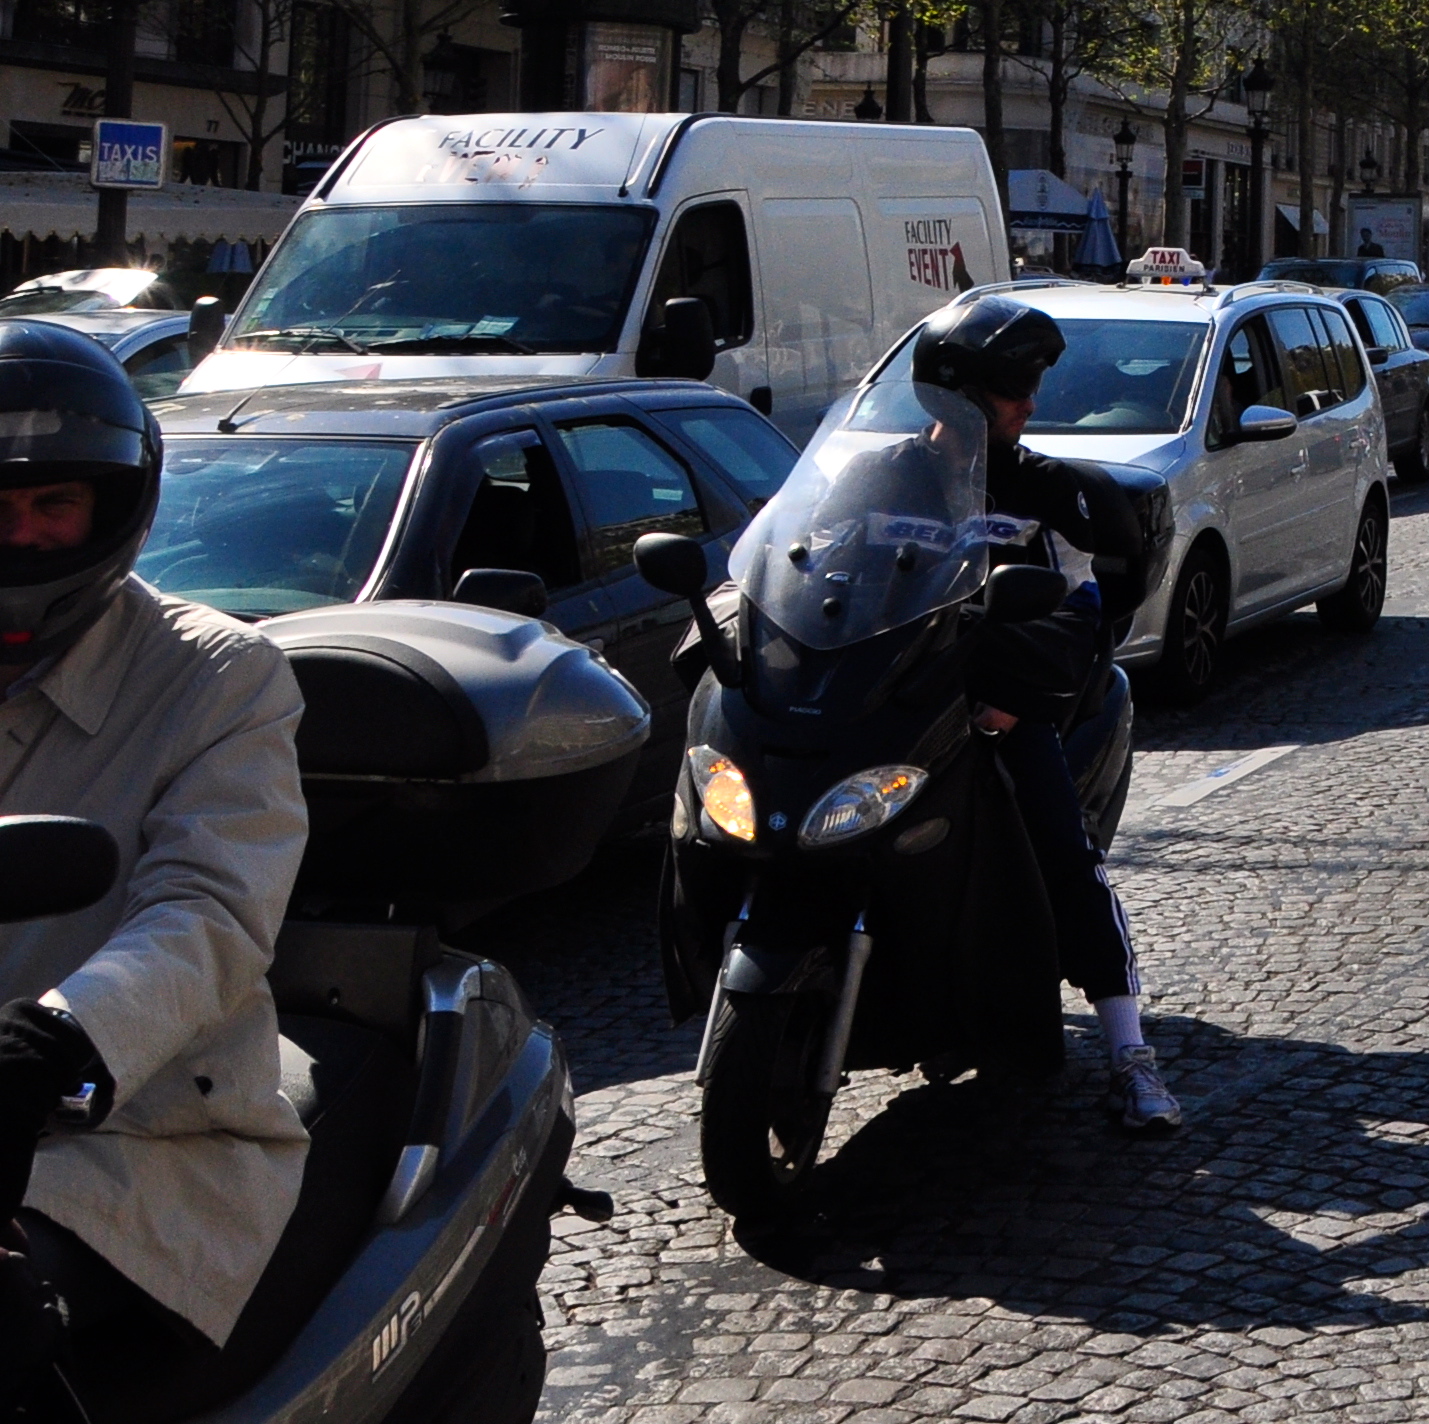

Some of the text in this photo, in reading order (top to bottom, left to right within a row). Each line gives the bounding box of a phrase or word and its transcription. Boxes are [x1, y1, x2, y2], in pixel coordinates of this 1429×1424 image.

[438, 128, 605, 150] FACILITY
[101, 141, 158, 163] TAXIS
[904, 219, 952, 245] FACILITY
[1143, 264, 1185, 273] PARISIEN
[1151, 251, 1181, 265] TAXI
[908, 248, 949, 291] EVENT
[789, 706, 822, 715] PIAGGIO
